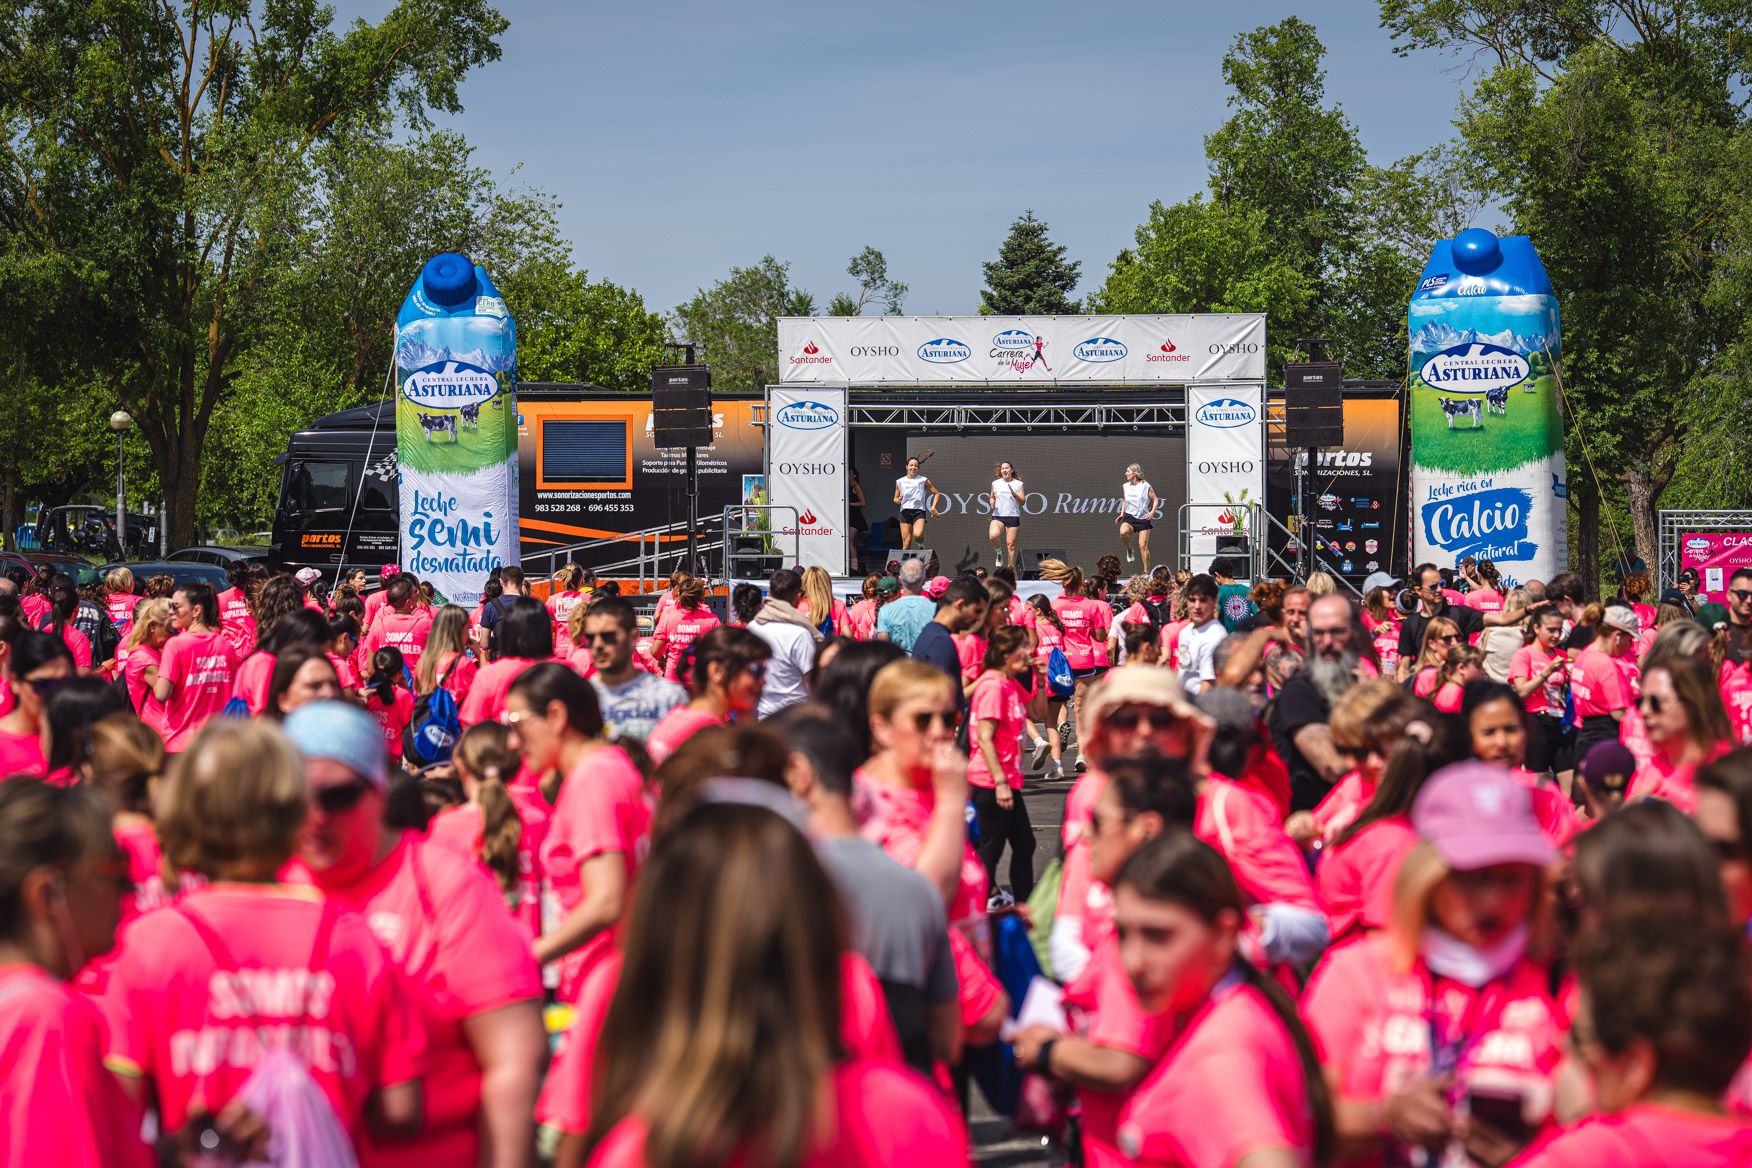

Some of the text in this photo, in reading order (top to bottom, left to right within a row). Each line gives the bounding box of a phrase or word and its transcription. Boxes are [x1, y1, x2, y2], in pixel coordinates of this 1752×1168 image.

[850, 345, 900, 358] OYSHO
[921, 347, 968, 358] ASTURIANA
[990, 348, 1024, 358] Carrera
[1078, 346, 1123, 357] ASTURIANA
[1208, 342, 1258, 354] OYSHO
[789, 356, 832, 364] Santander
[1146, 354, 1190, 362] Santander
[1009, 358, 1036, 374] Mujer
[1427, 362, 1522, 382] ASTURIANA
[408, 378, 492, 397] ASTURIANA
[782, 410, 834, 423] ASTURIANA
[1200, 410, 1252, 421] ASTURIANA
[779, 462, 836, 476] OYSHO
[1198, 461, 1254, 474] OYSHO
[537, 490, 632, 500] www.sonorizacionesportos.com
[1427, 478, 1493, 501] Leche rica en
[410, 490, 458, 519] Leche
[926, 492, 1048, 515] OYSO
[1430, 500, 1520, 545] Calcio
[408, 512, 500, 550] semi
[1469, 540, 1518, 562] natural
[410, 548, 503, 574] desnatada
[385, 632, 413, 642] SOMOS
